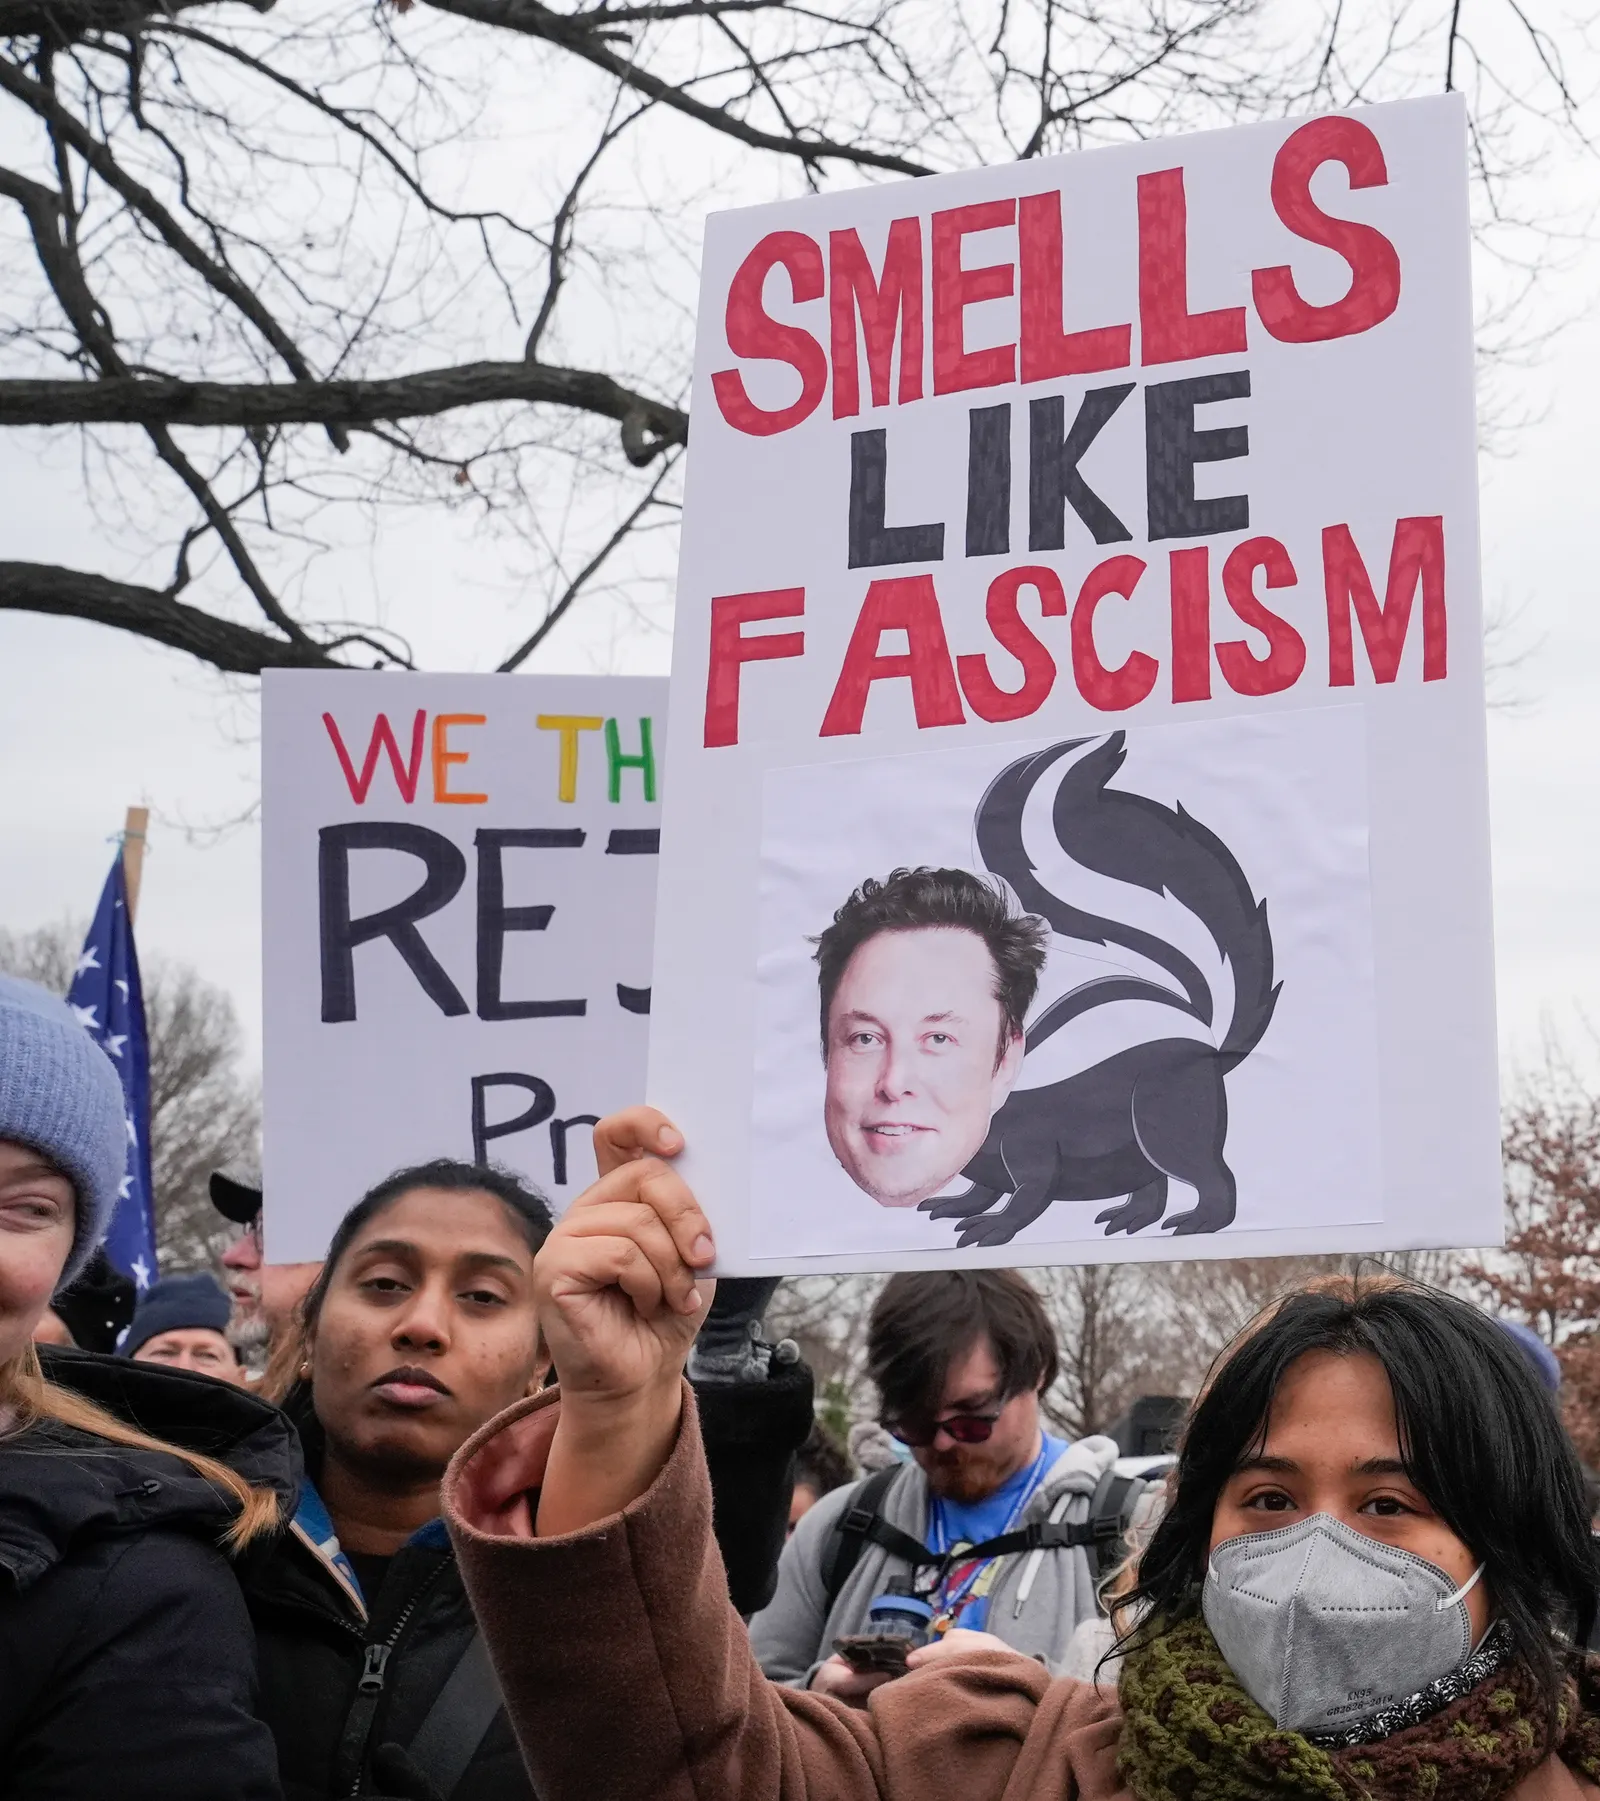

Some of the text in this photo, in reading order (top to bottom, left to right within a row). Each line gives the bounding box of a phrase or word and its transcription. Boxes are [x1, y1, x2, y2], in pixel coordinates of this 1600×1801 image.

[711, 115, 1401, 436] SMELLS
[848, 371, 1251, 569] LIKE
[704, 516, 1447, 749] FASCISM
[322, 709, 657, 805] WE TH
[471, 1072, 602, 1186] Pr
[1347, 1688, 1373, 1701] KN95
